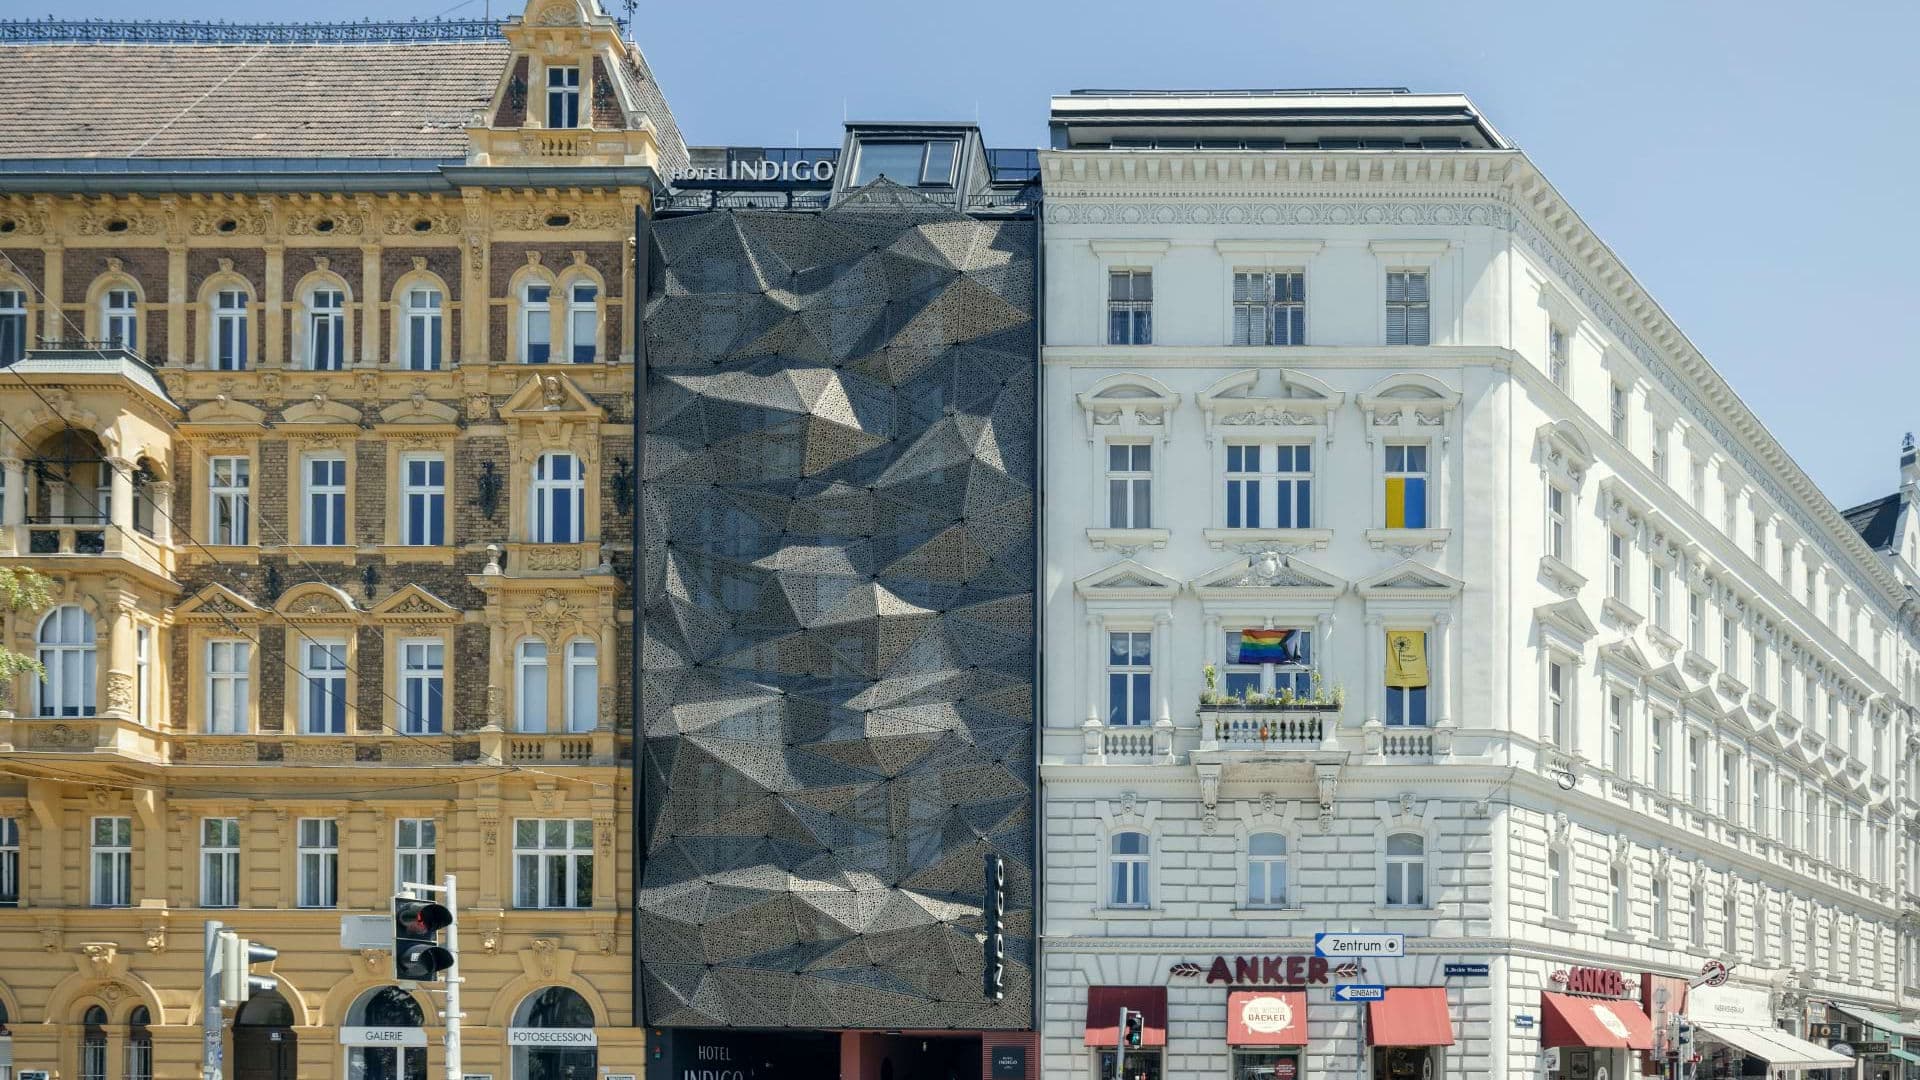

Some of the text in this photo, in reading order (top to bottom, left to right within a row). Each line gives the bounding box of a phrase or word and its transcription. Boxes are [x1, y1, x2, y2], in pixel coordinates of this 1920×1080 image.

[671, 160, 834, 181] HOTEL INDIGO
[1332, 939, 1382, 951] Zentrum
[1206, 956, 1329, 985] ANKER
[1567, 966, 1623, 996] ANKER
[1350, 989, 1379, 997] EINBAHN
[365, 1031, 403, 1041] GALERIE
[513, 1031, 592, 1042] FOTOSECESSION
[698, 1045, 732, 1061] HOTEL
